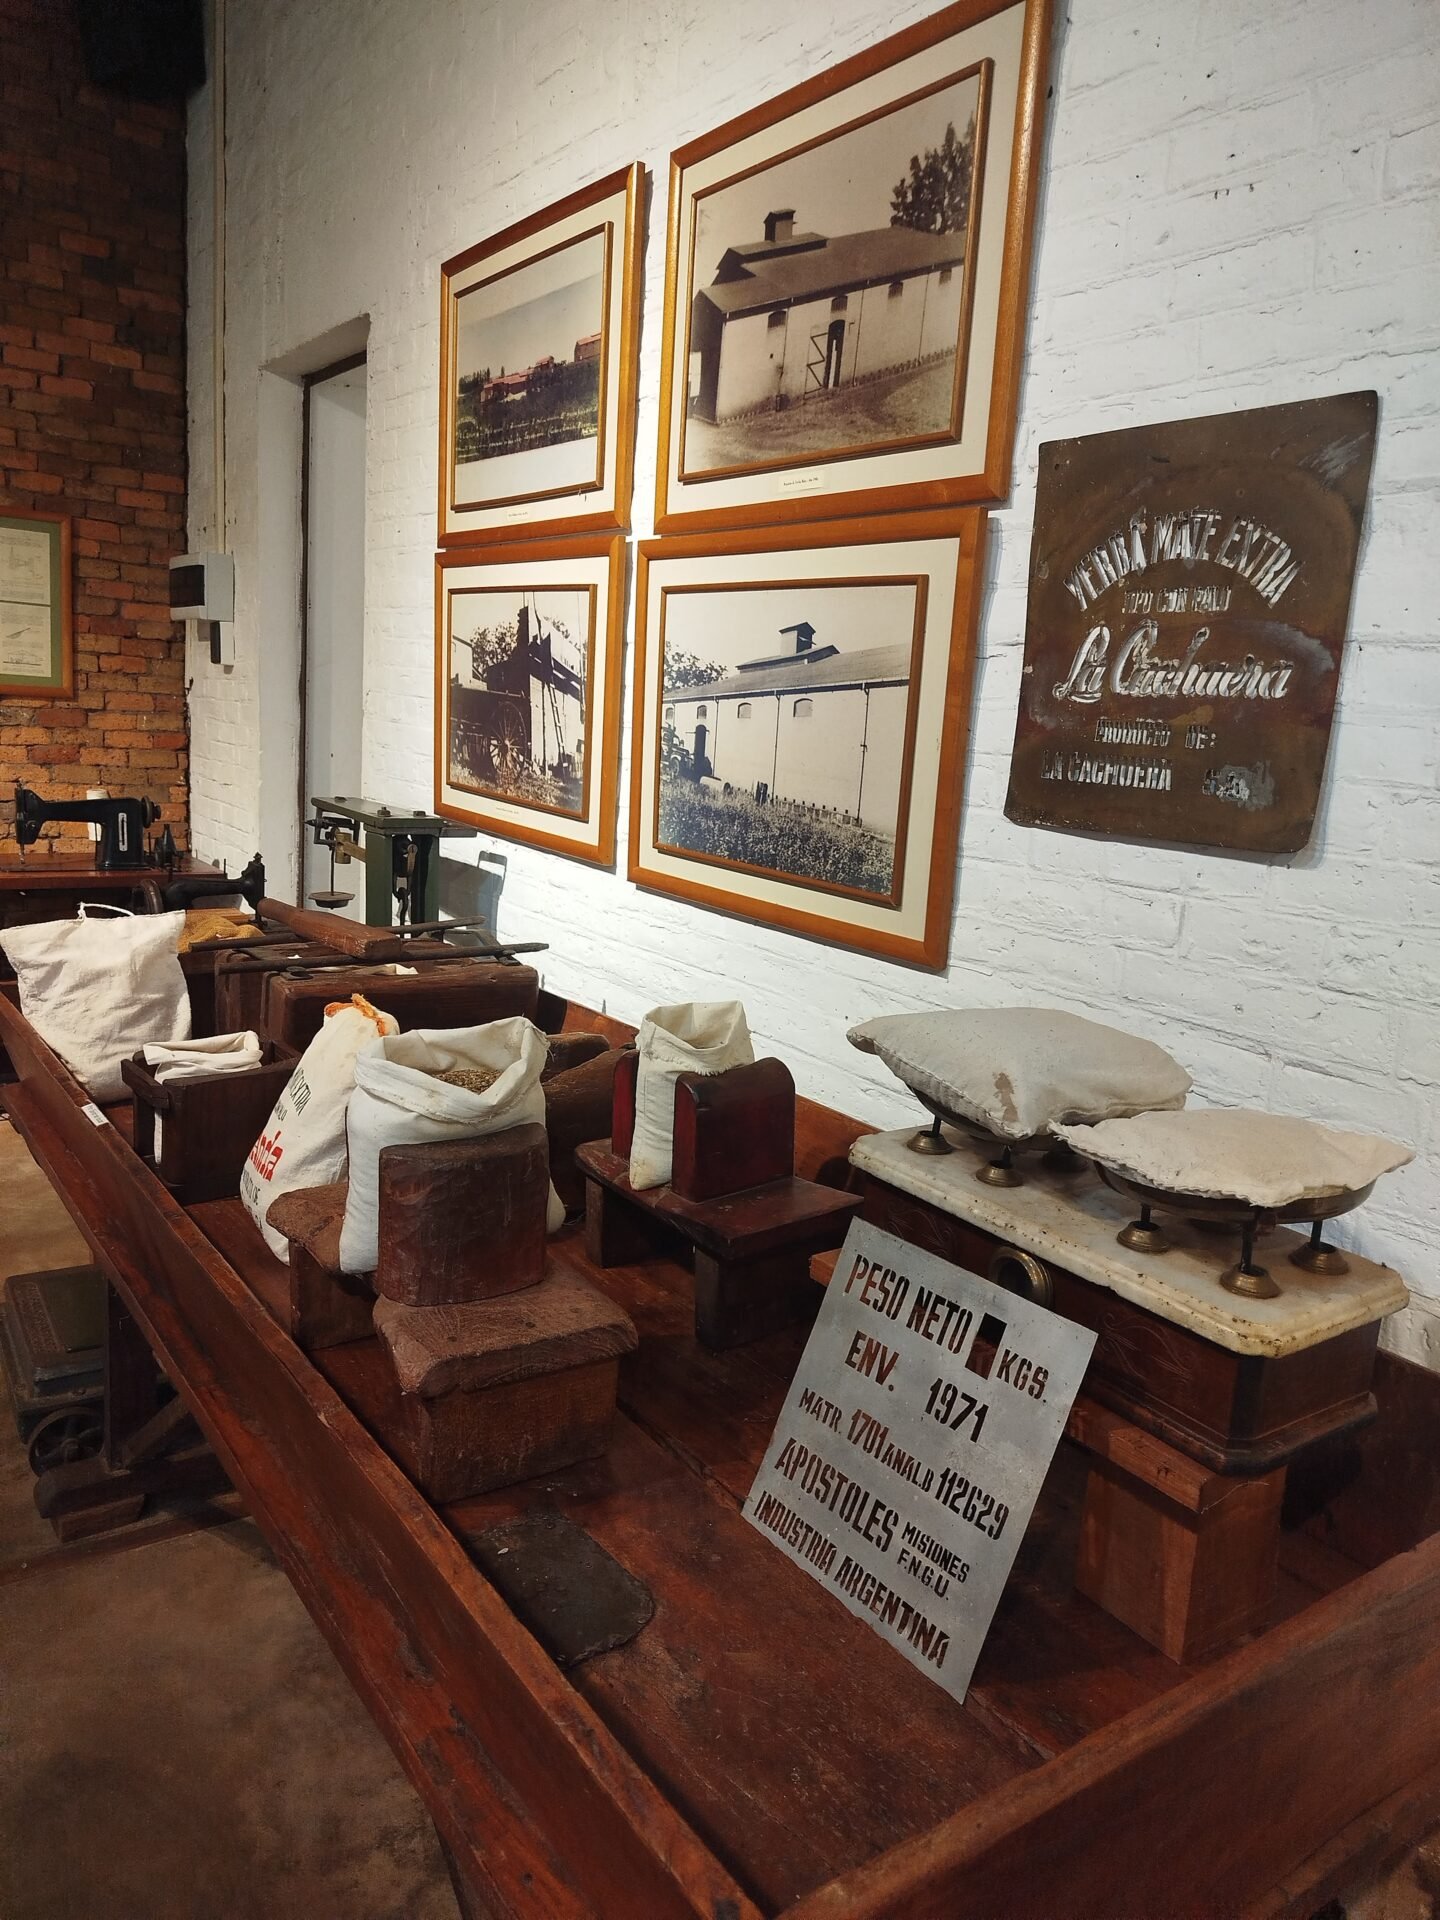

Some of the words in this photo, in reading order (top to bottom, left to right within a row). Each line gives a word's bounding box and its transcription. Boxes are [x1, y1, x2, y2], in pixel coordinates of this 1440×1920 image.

[1150, 508, 1222, 563] MATE
[1214, 515, 1299, 610] EXTRA
[1052, 622, 1111, 703] La
[1040, 750, 1063, 780] LA
[843, 1253, 911, 1322] PESO
[906, 1285, 974, 1355] NETO
[996, 1347, 1050, 1403] KGS.
[844, 1329, 900, 1393] ENV.
[924, 1376, 990, 1444] 1971
[774, 1436, 900, 1553] APOSTOLES
[901, 1521, 971, 1585] MISIONES
[798, 1386, 843, 1436] MATR.
[846, 1408, 890, 1460] 1701
[935, 1466, 1010, 1542] 112629
[753, 1490, 838, 1576] INDUSTRIA
[834, 1554, 951, 1670] ARGENTINA
